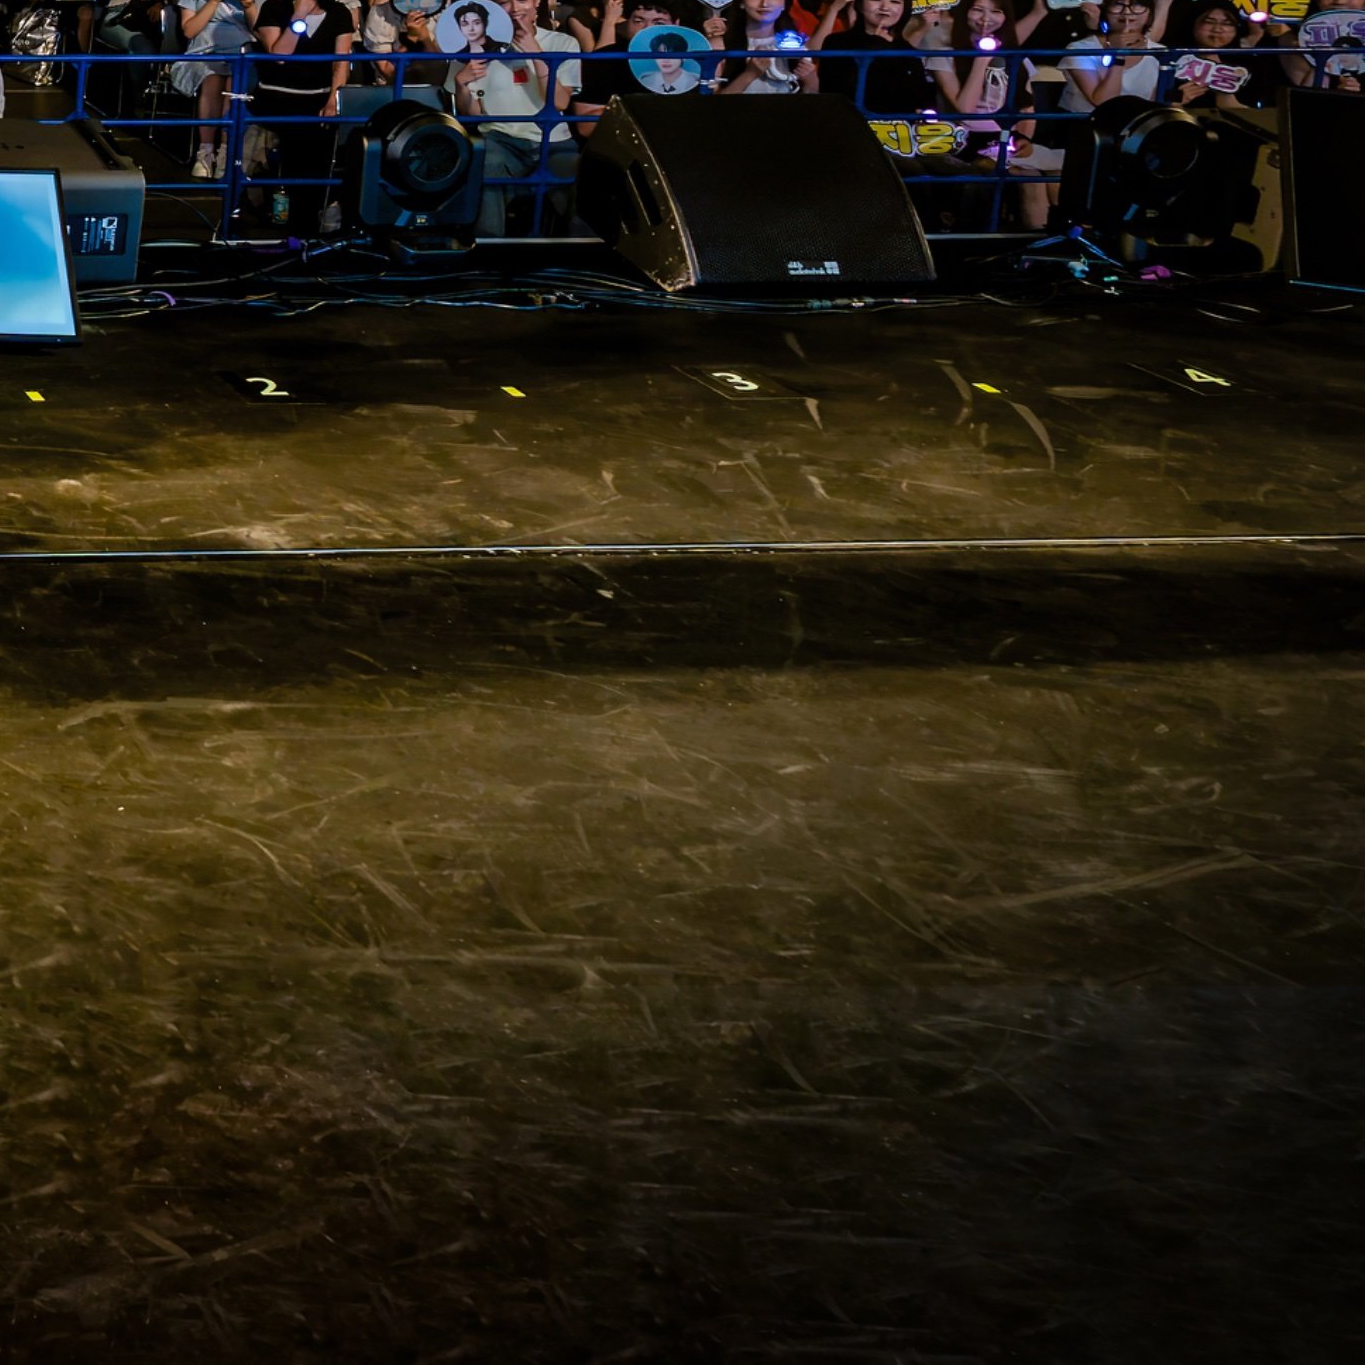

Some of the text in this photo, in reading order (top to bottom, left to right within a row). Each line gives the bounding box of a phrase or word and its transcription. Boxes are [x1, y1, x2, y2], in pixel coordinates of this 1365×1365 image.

[1187, 61, 1249, 94] 지웅
[873, 123, 956, 155] 지웅
[711, 372, 759, 391] 3
[1184, 368, 1232, 386] 4
[246, 378, 289, 396] 2
